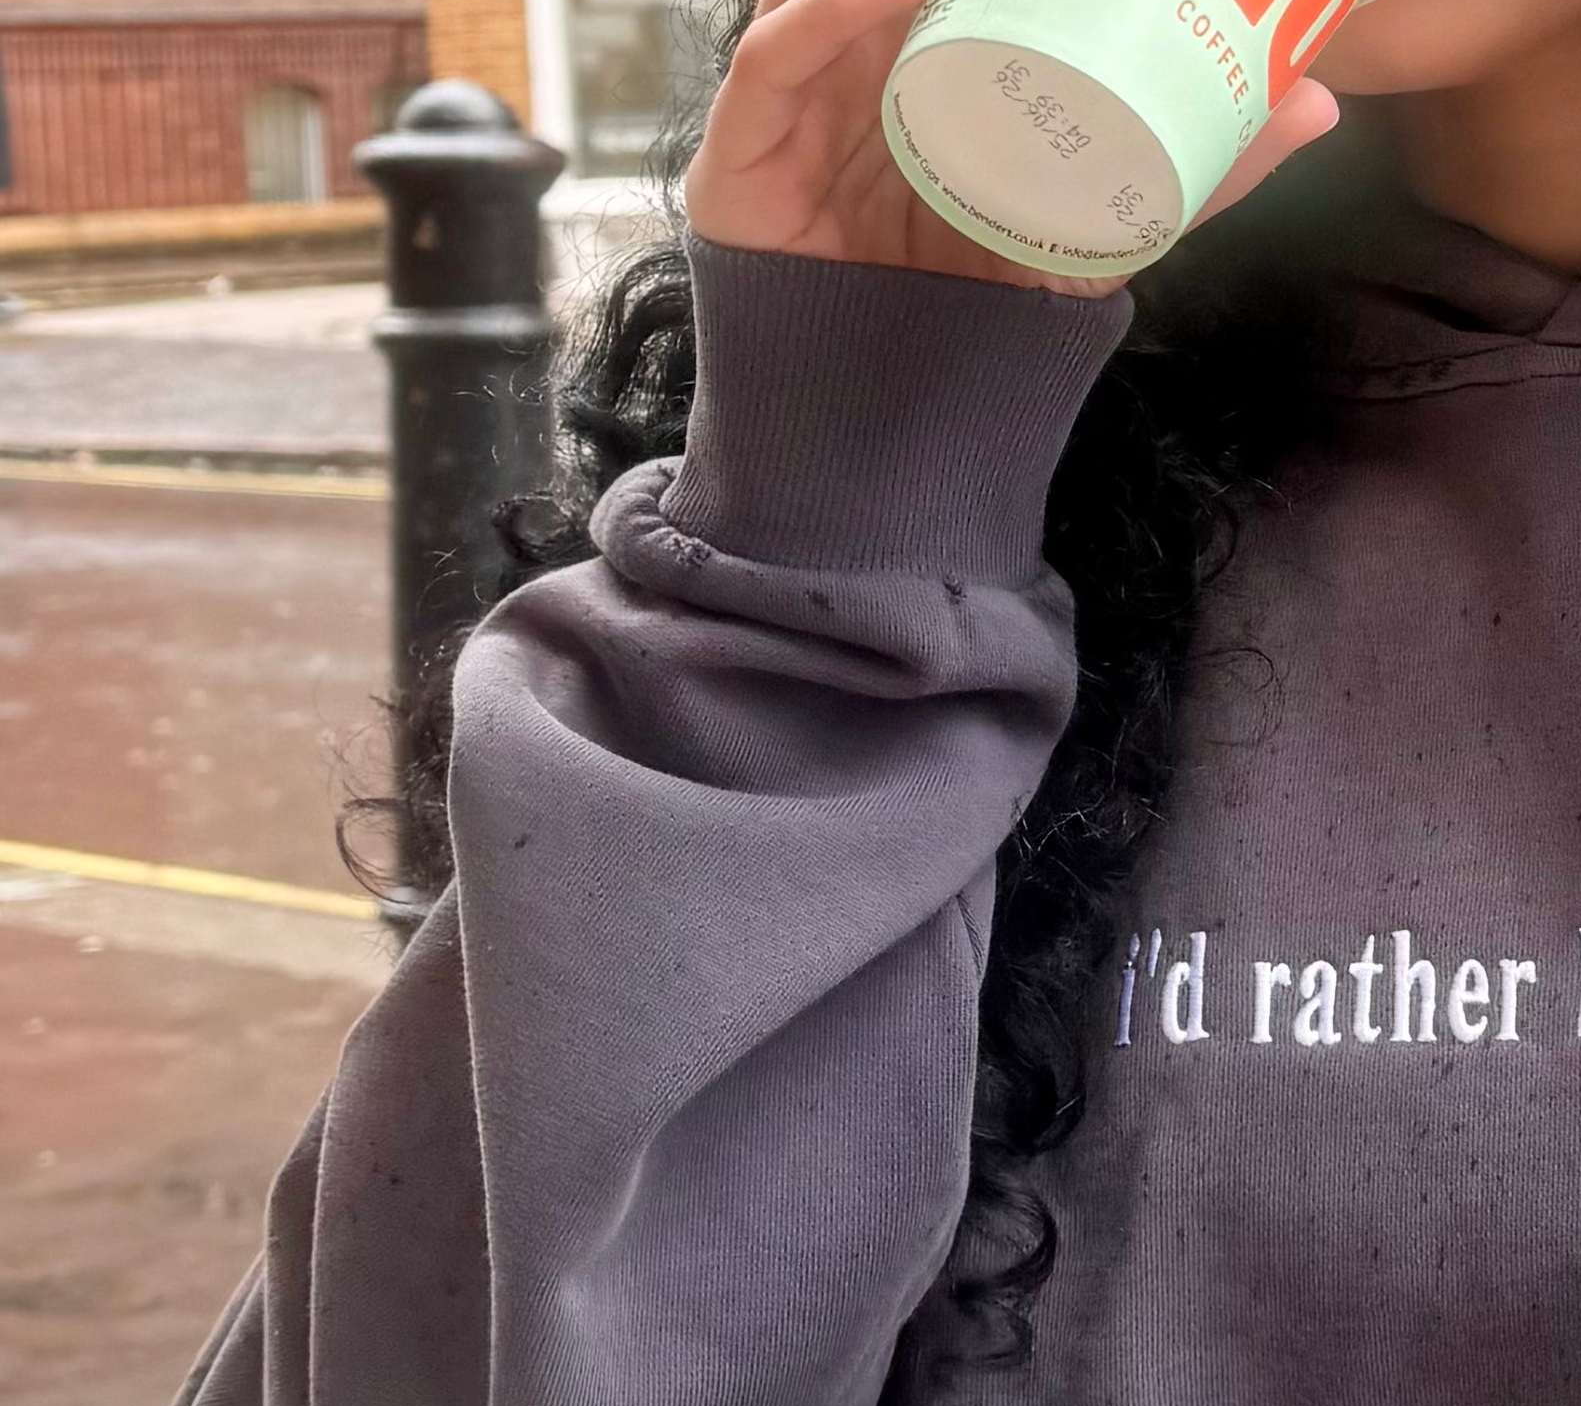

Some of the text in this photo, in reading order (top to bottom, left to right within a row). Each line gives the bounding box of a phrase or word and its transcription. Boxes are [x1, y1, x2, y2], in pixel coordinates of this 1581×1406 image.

[919, 158, 940, 185] Cups
[1113, 927, 1212, 1047] i'd
[1251, 928, 1537, 1047] rather
